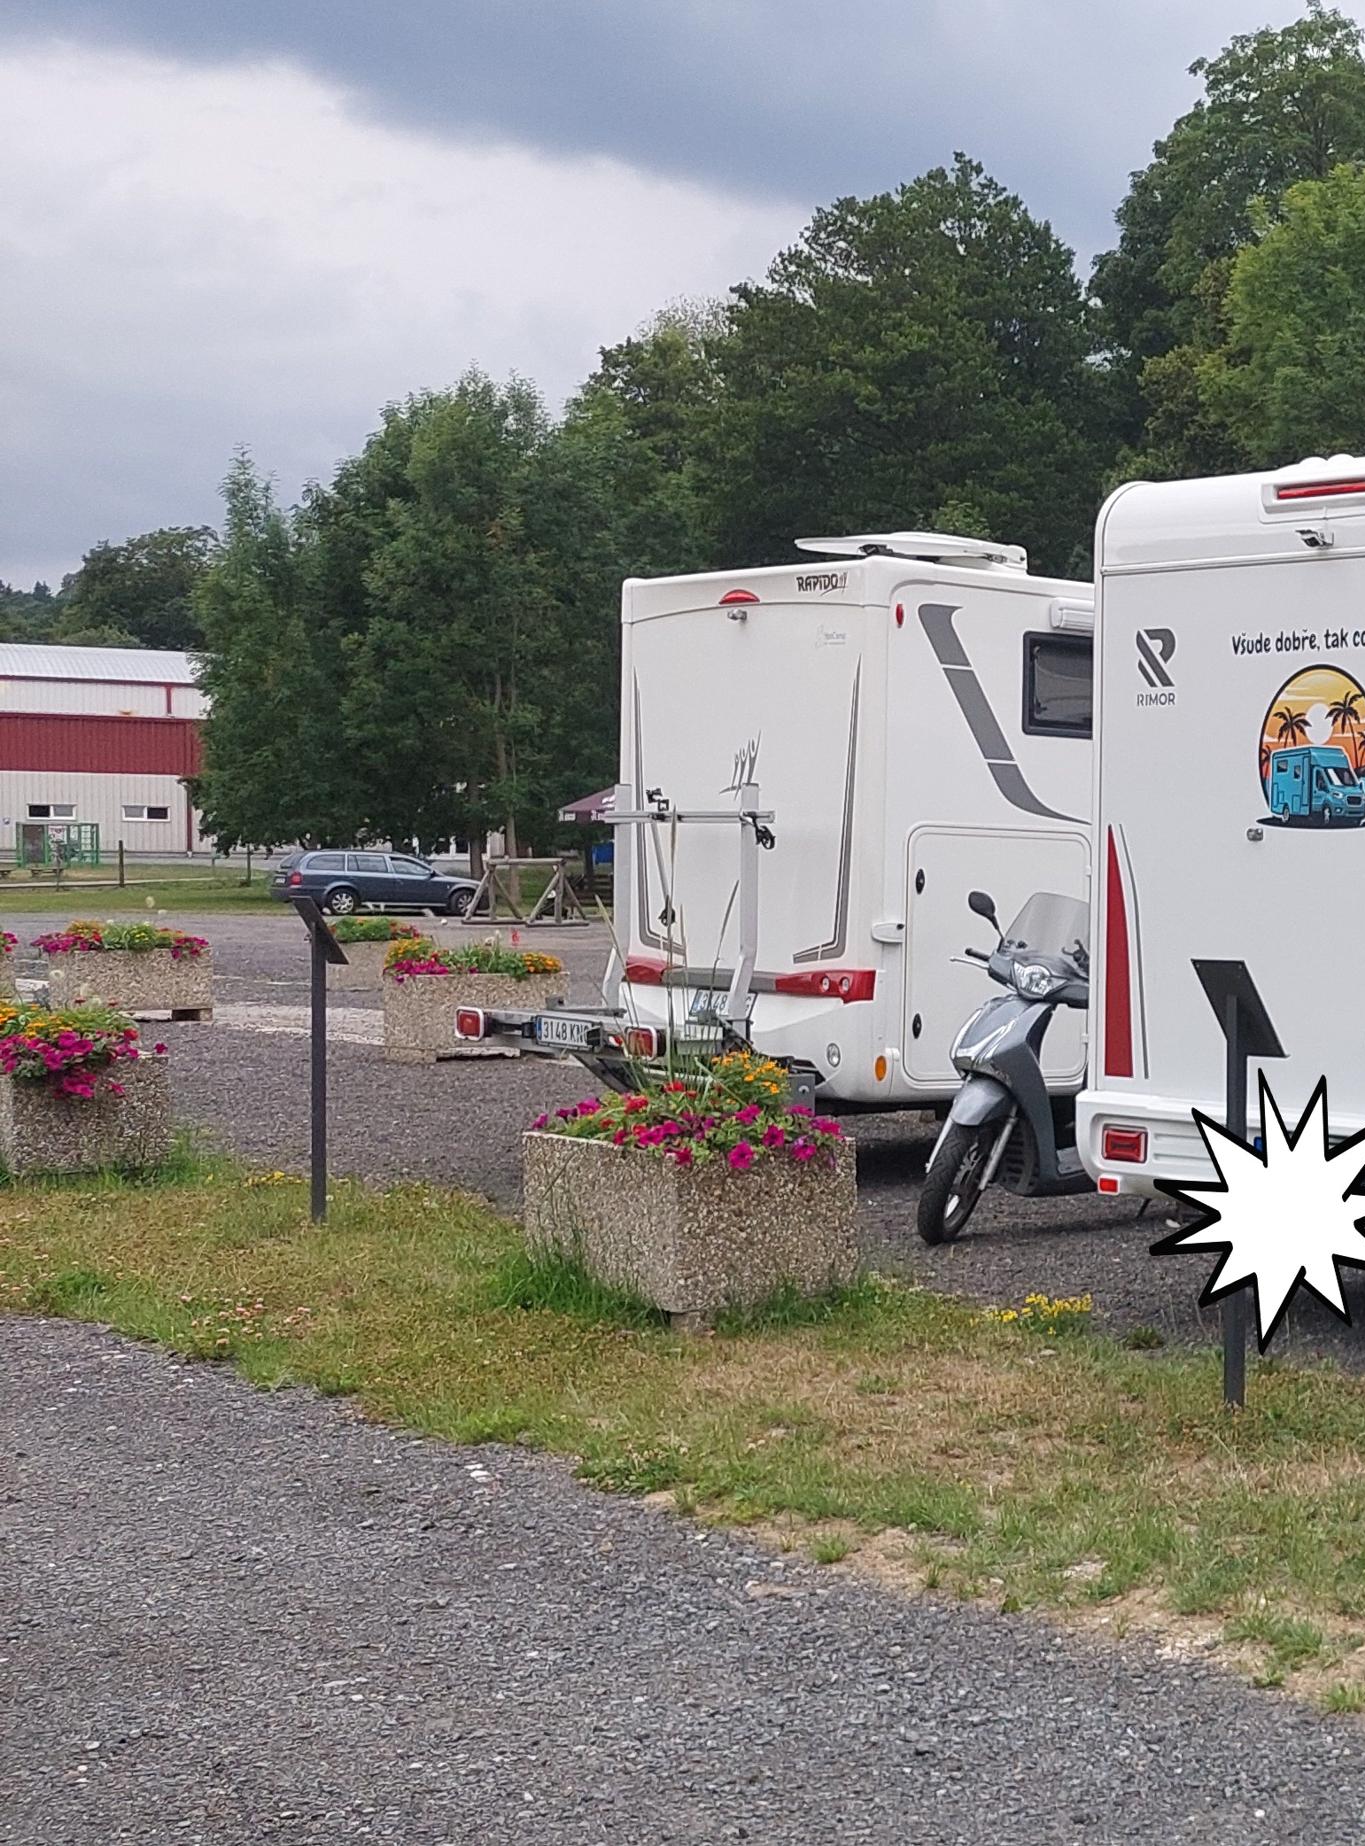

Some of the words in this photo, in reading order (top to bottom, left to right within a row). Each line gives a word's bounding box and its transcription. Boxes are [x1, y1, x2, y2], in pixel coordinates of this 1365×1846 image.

[796, 573, 841, 593] RAPIDO
[1232, 632, 1271, 655] Všude
[1275, 629, 1321, 652] dobře,
[1324, 627, 1349, 650] tak
[1137, 692, 1176, 706] RIMOR
[543, 1021, 568, 1041] 3148
